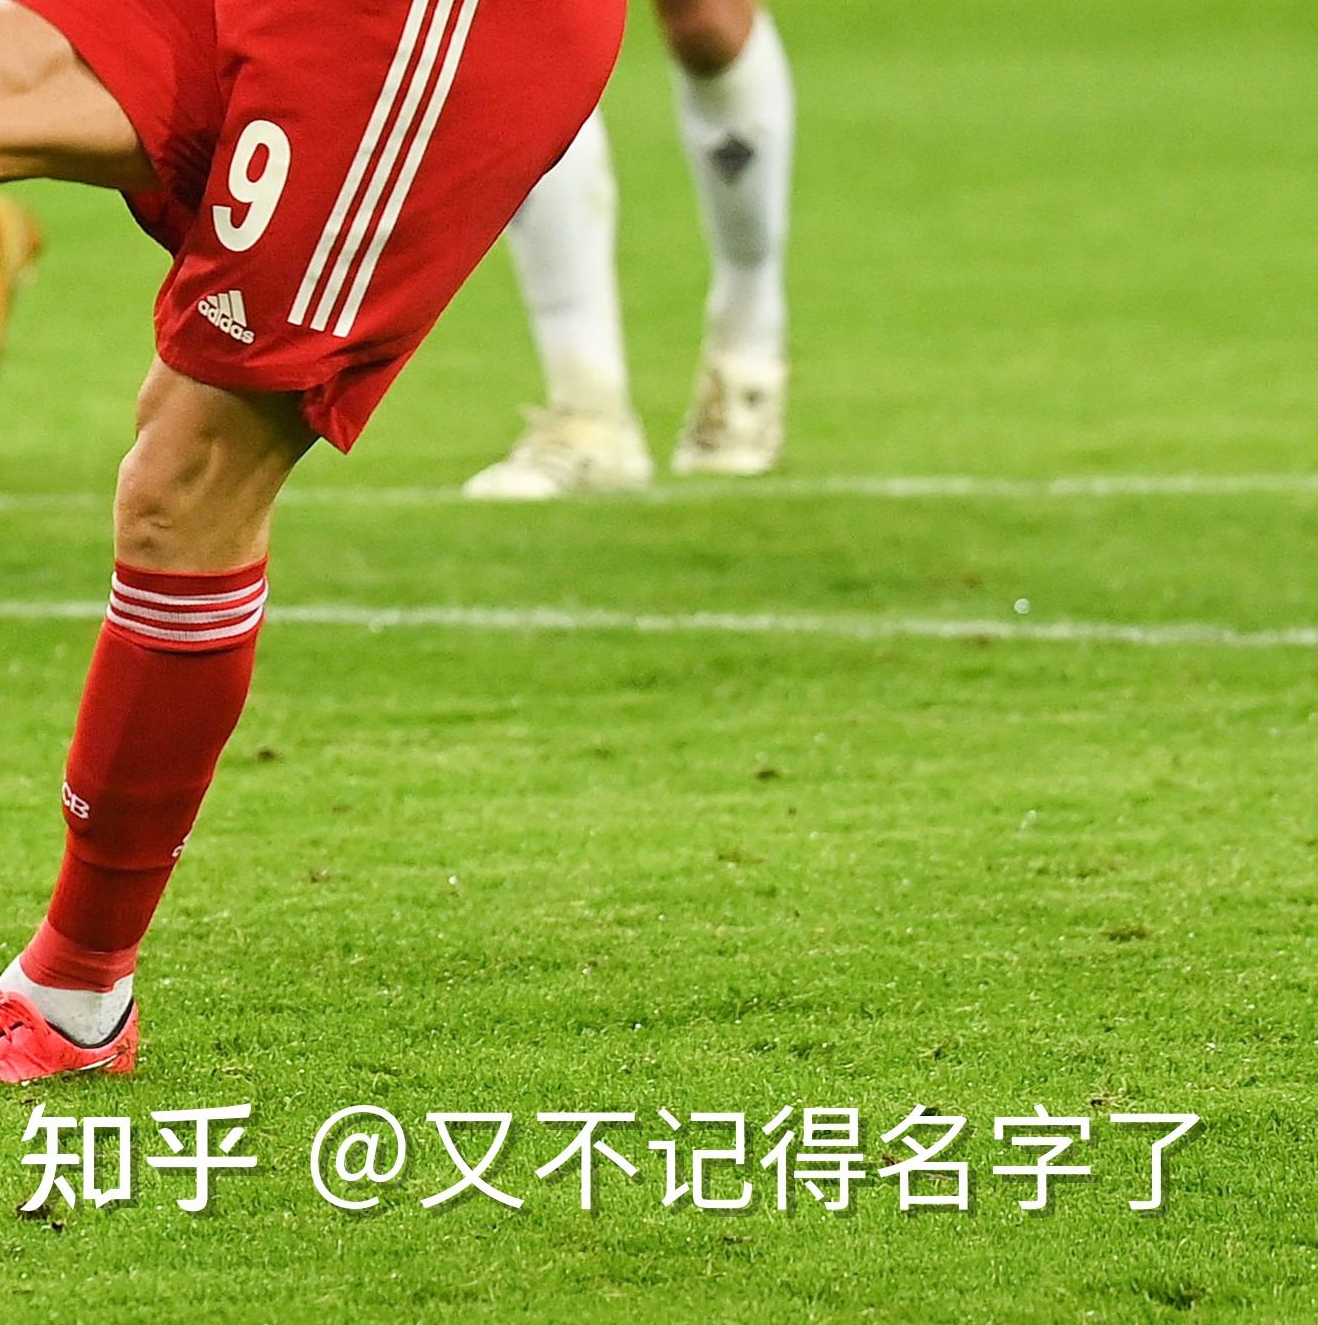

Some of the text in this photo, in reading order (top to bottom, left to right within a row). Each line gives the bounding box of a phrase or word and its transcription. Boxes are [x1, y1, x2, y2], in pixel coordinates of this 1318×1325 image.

[212, 119, 292, 253] 9
[197, 299, 255, 345] adidas
[61, 781, 90, 819] CB
